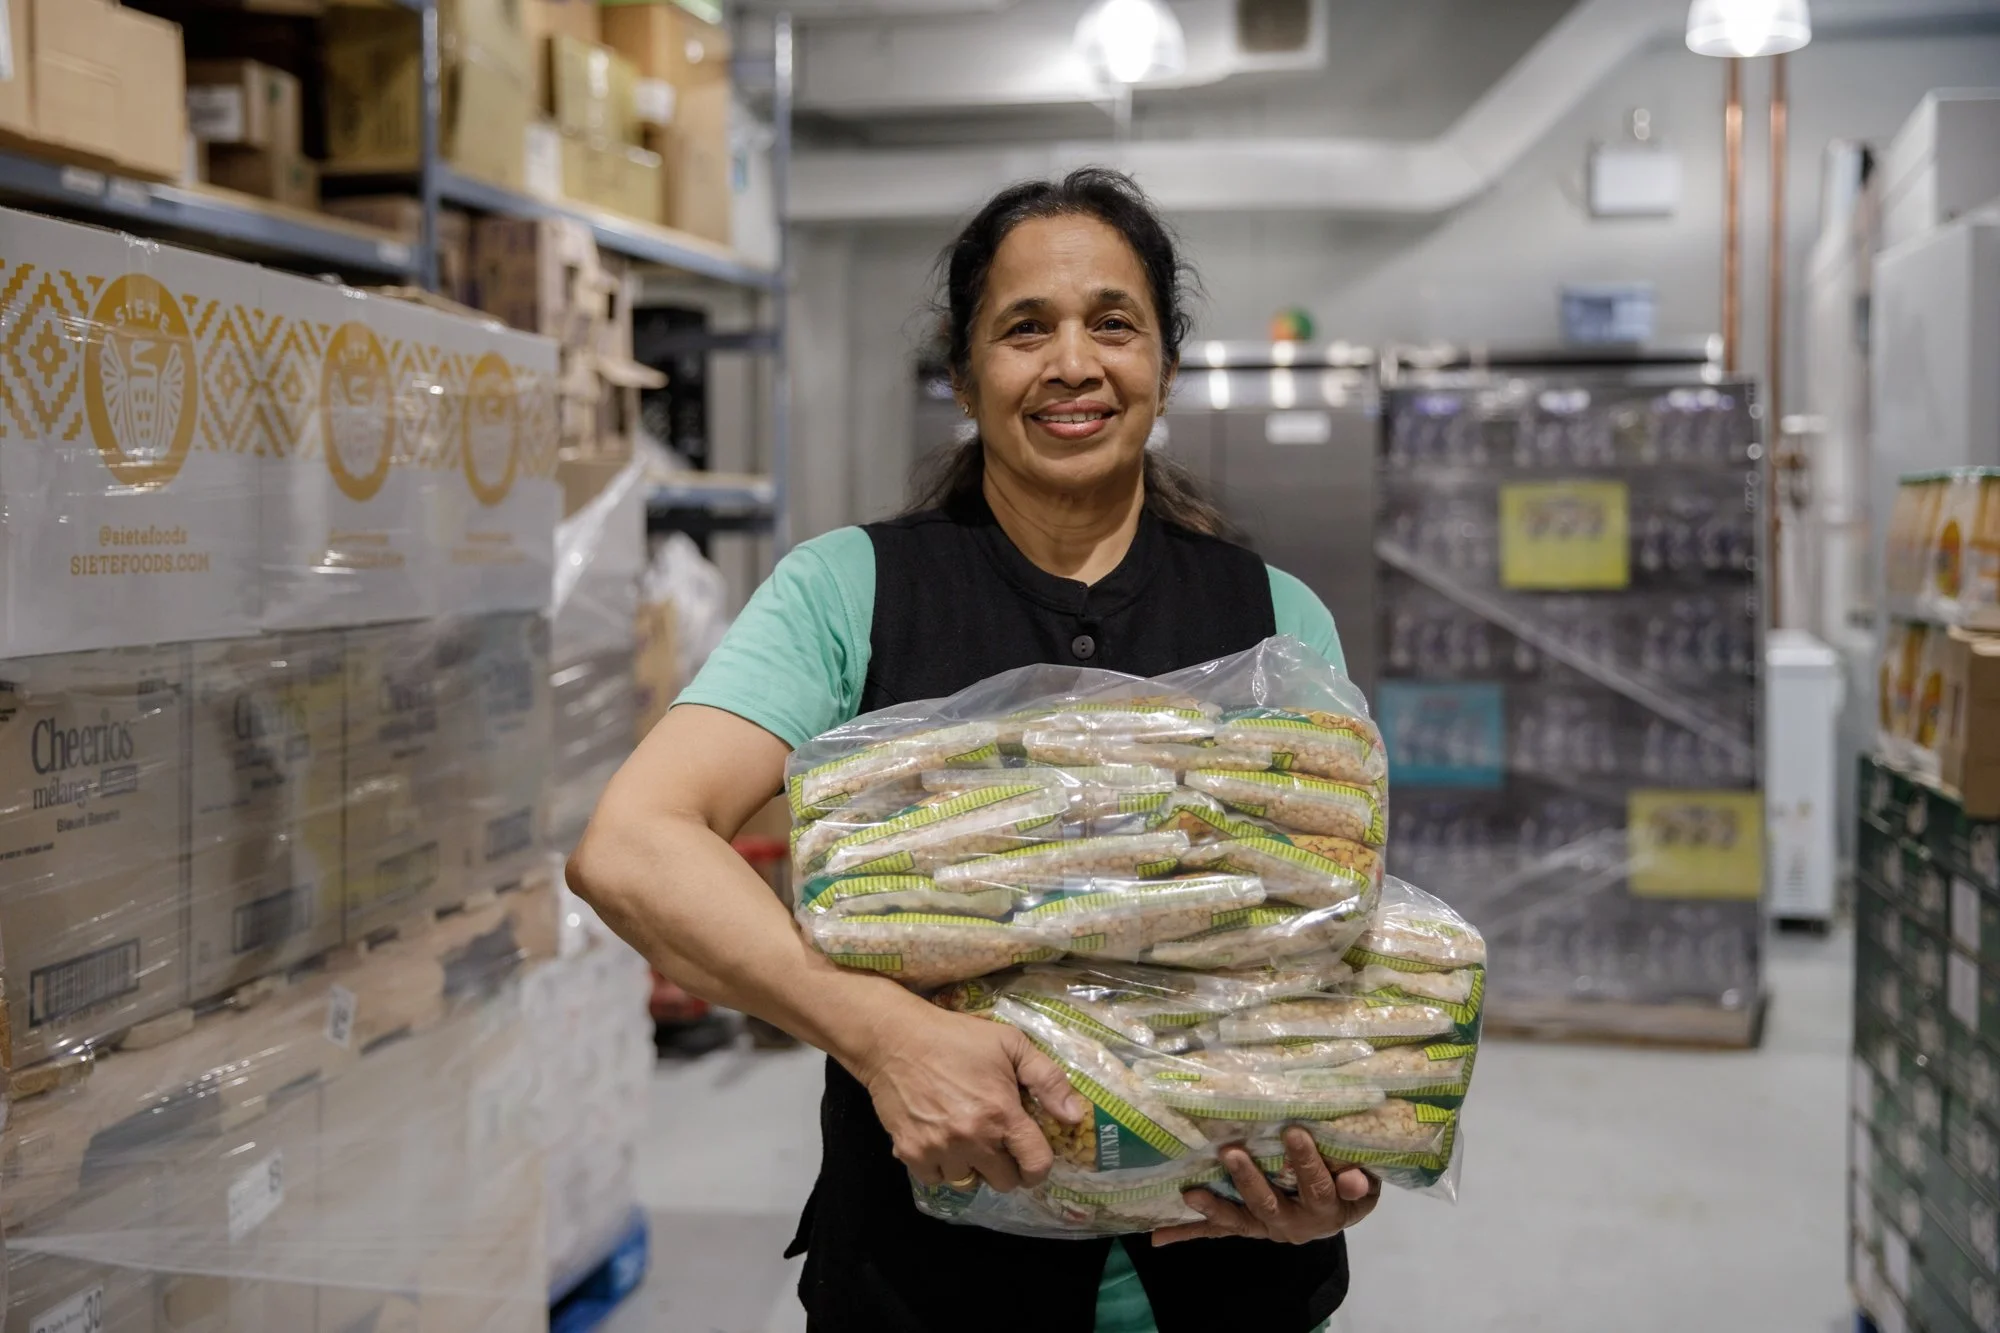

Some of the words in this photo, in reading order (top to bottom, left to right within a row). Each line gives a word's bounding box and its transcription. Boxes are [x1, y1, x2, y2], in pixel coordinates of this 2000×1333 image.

[114, 298, 170, 336] SIETE
[99, 524, 188, 547] @sietefoods
[70, 551, 210, 576] SIETEFOODS.COM
[31, 717, 134, 775] Cheerios
[1100, 1123, 1120, 1166] JAUNES
